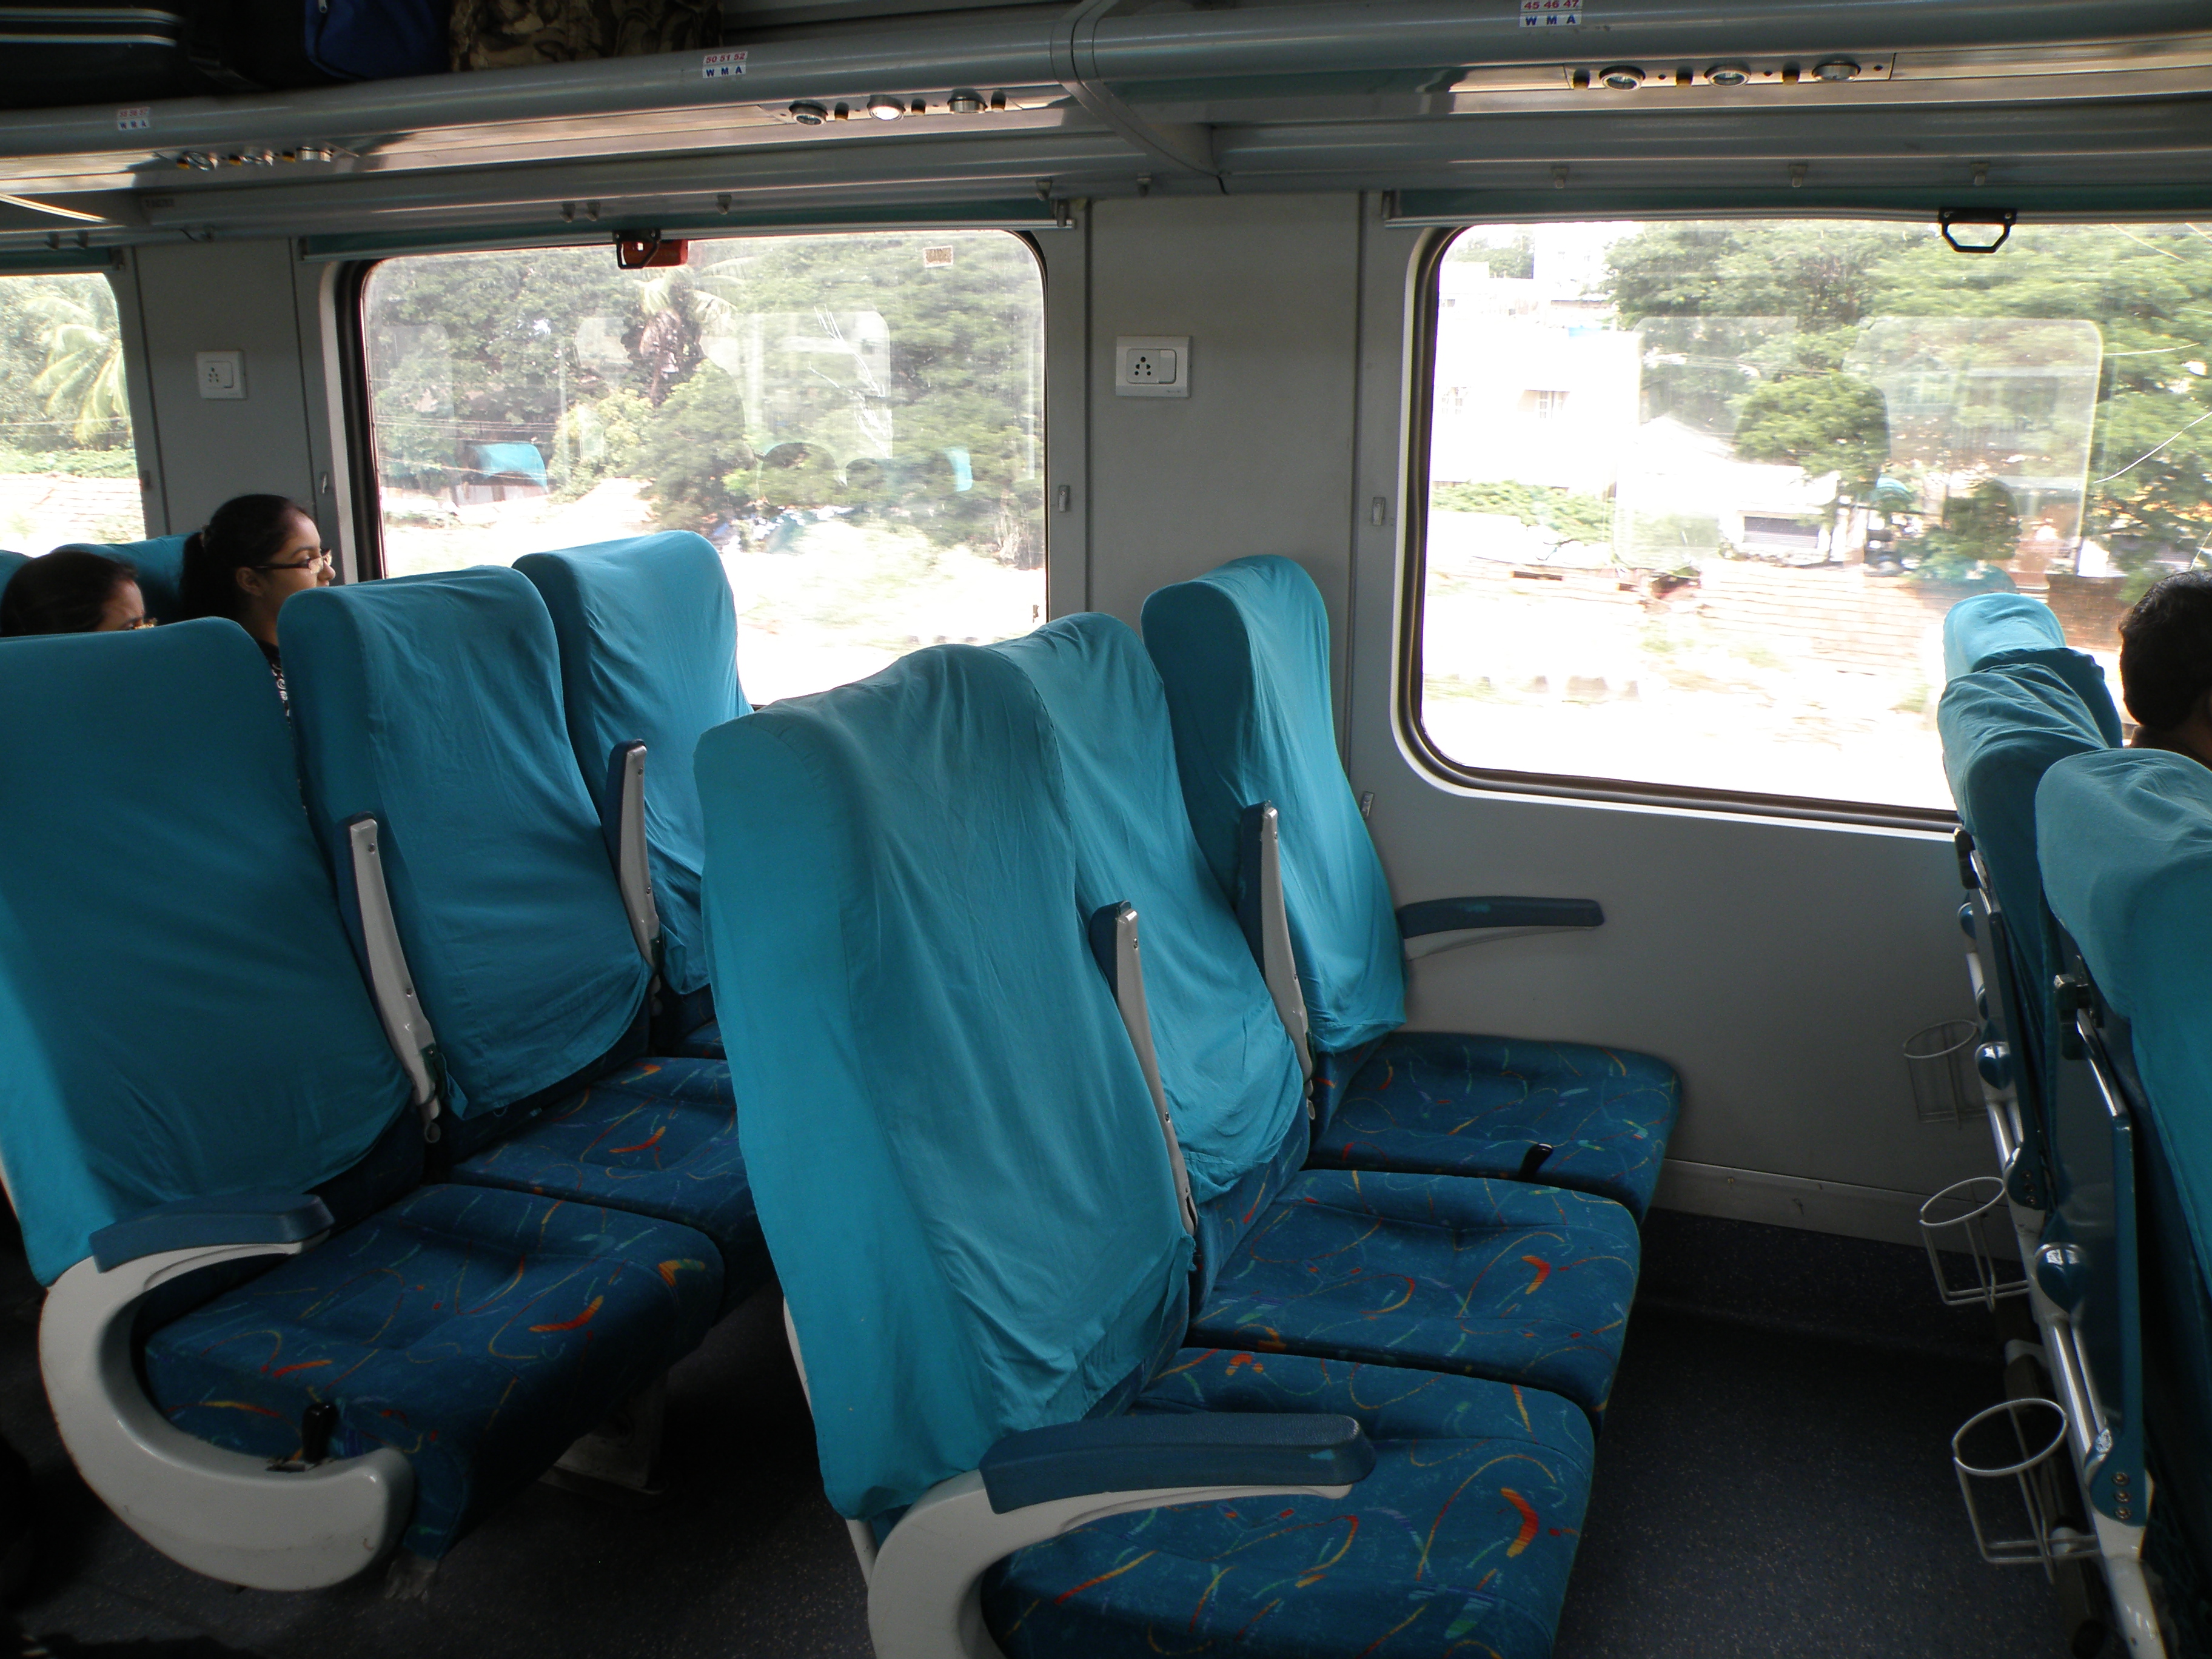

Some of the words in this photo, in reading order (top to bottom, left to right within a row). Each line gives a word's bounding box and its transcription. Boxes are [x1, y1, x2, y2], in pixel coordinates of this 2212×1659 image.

[1524, 1, 1540, 10] 45
[1543, 1, 1560, 9] 46
[1525, 16, 1538, 25] W
[1546, 15, 1558, 25] M
[1566, 15, 1577, 24] A
[706, 69, 715, 77] W
[721, 67, 729, 75] M
[735, 65, 742, 74] A
